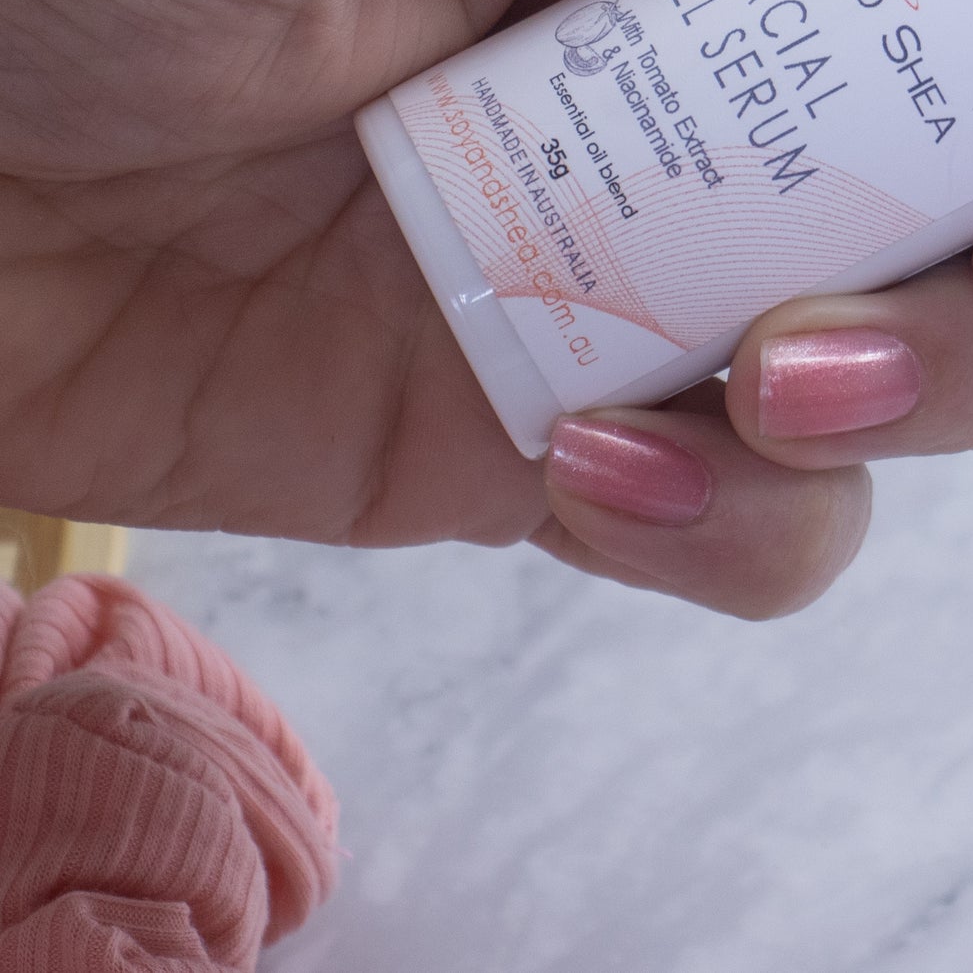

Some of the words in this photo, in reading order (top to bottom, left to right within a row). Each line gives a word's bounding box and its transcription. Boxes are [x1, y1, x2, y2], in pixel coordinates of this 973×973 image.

[602, 45, 621, 61] &
[617, 9, 645, 46] With
[636, 44, 680, 114] Tomato
[674, 116, 725, 189] Extract
[700, 28, 820, 195] SERUM
[882, 25, 956, 144] SHEA
[471, 77, 528, 164] HANDMADE
[517, 163, 540, 186] IN
[541, 138, 570, 180] 35g
[549, 72, 596, 140] Essential
[586, 141, 608, 164] oil
[599, 163, 638, 219] blend
[610, 61, 682, 178] Niacinamide
[426, 71, 599, 367] www.soyandshea.com.au
[528, 187, 597, 294] AUSTRALIA
